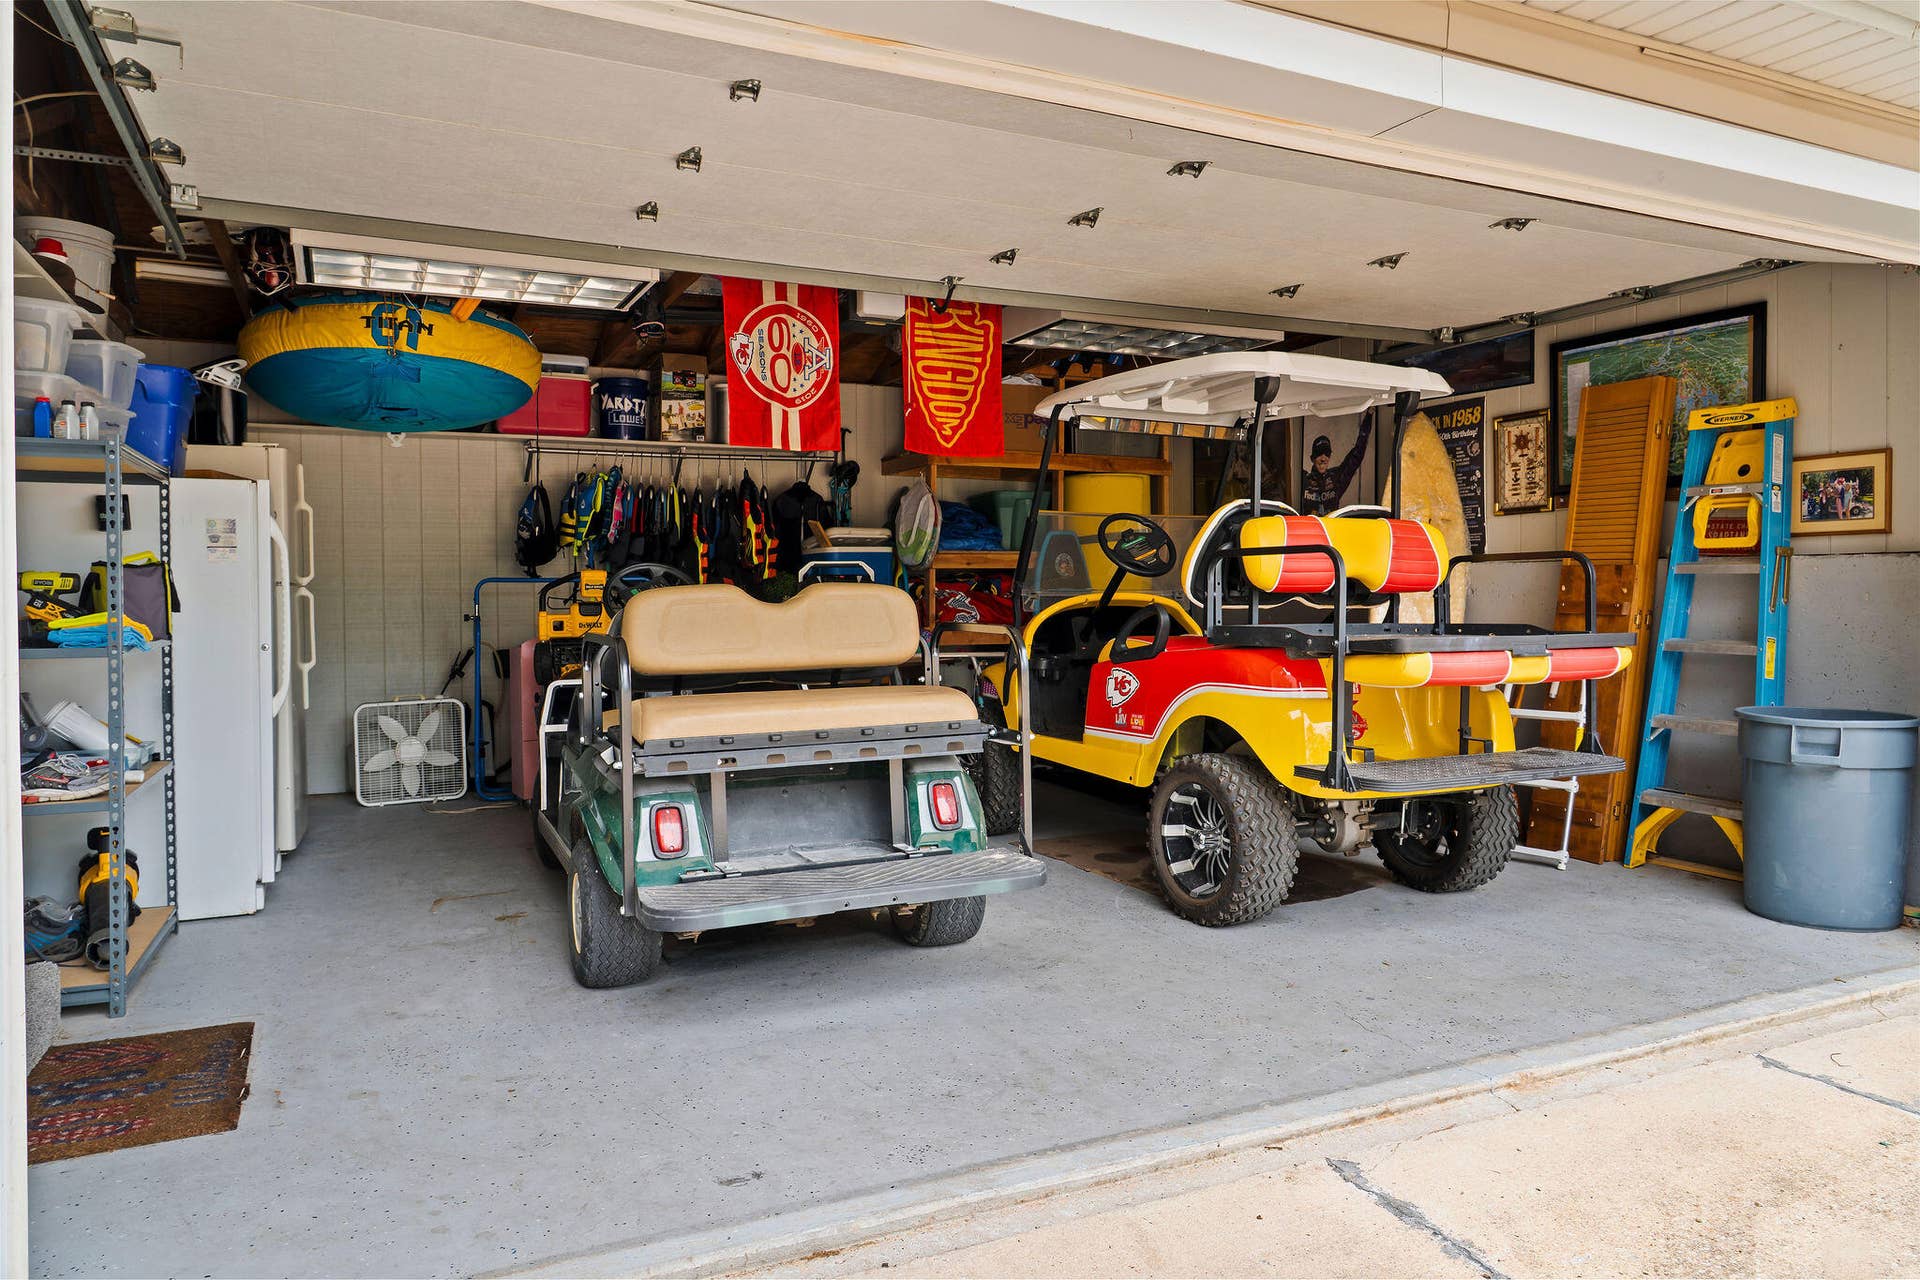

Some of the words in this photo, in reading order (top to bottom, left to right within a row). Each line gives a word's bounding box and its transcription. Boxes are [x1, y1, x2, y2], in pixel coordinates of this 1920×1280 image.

[359, 315, 434, 336] TITAN
[795, 312, 819, 333] 1960
[757, 328, 768, 382] SEASONS
[767, 316, 792, 394] 60
[914, 306, 985, 436] KINGDOM
[1451, 406, 1482, 429] 1958
[1713, 413, 1746, 424] WERNER
[1440, 431, 1452, 441] 0th
[1113, 675, 1132, 697] KC
